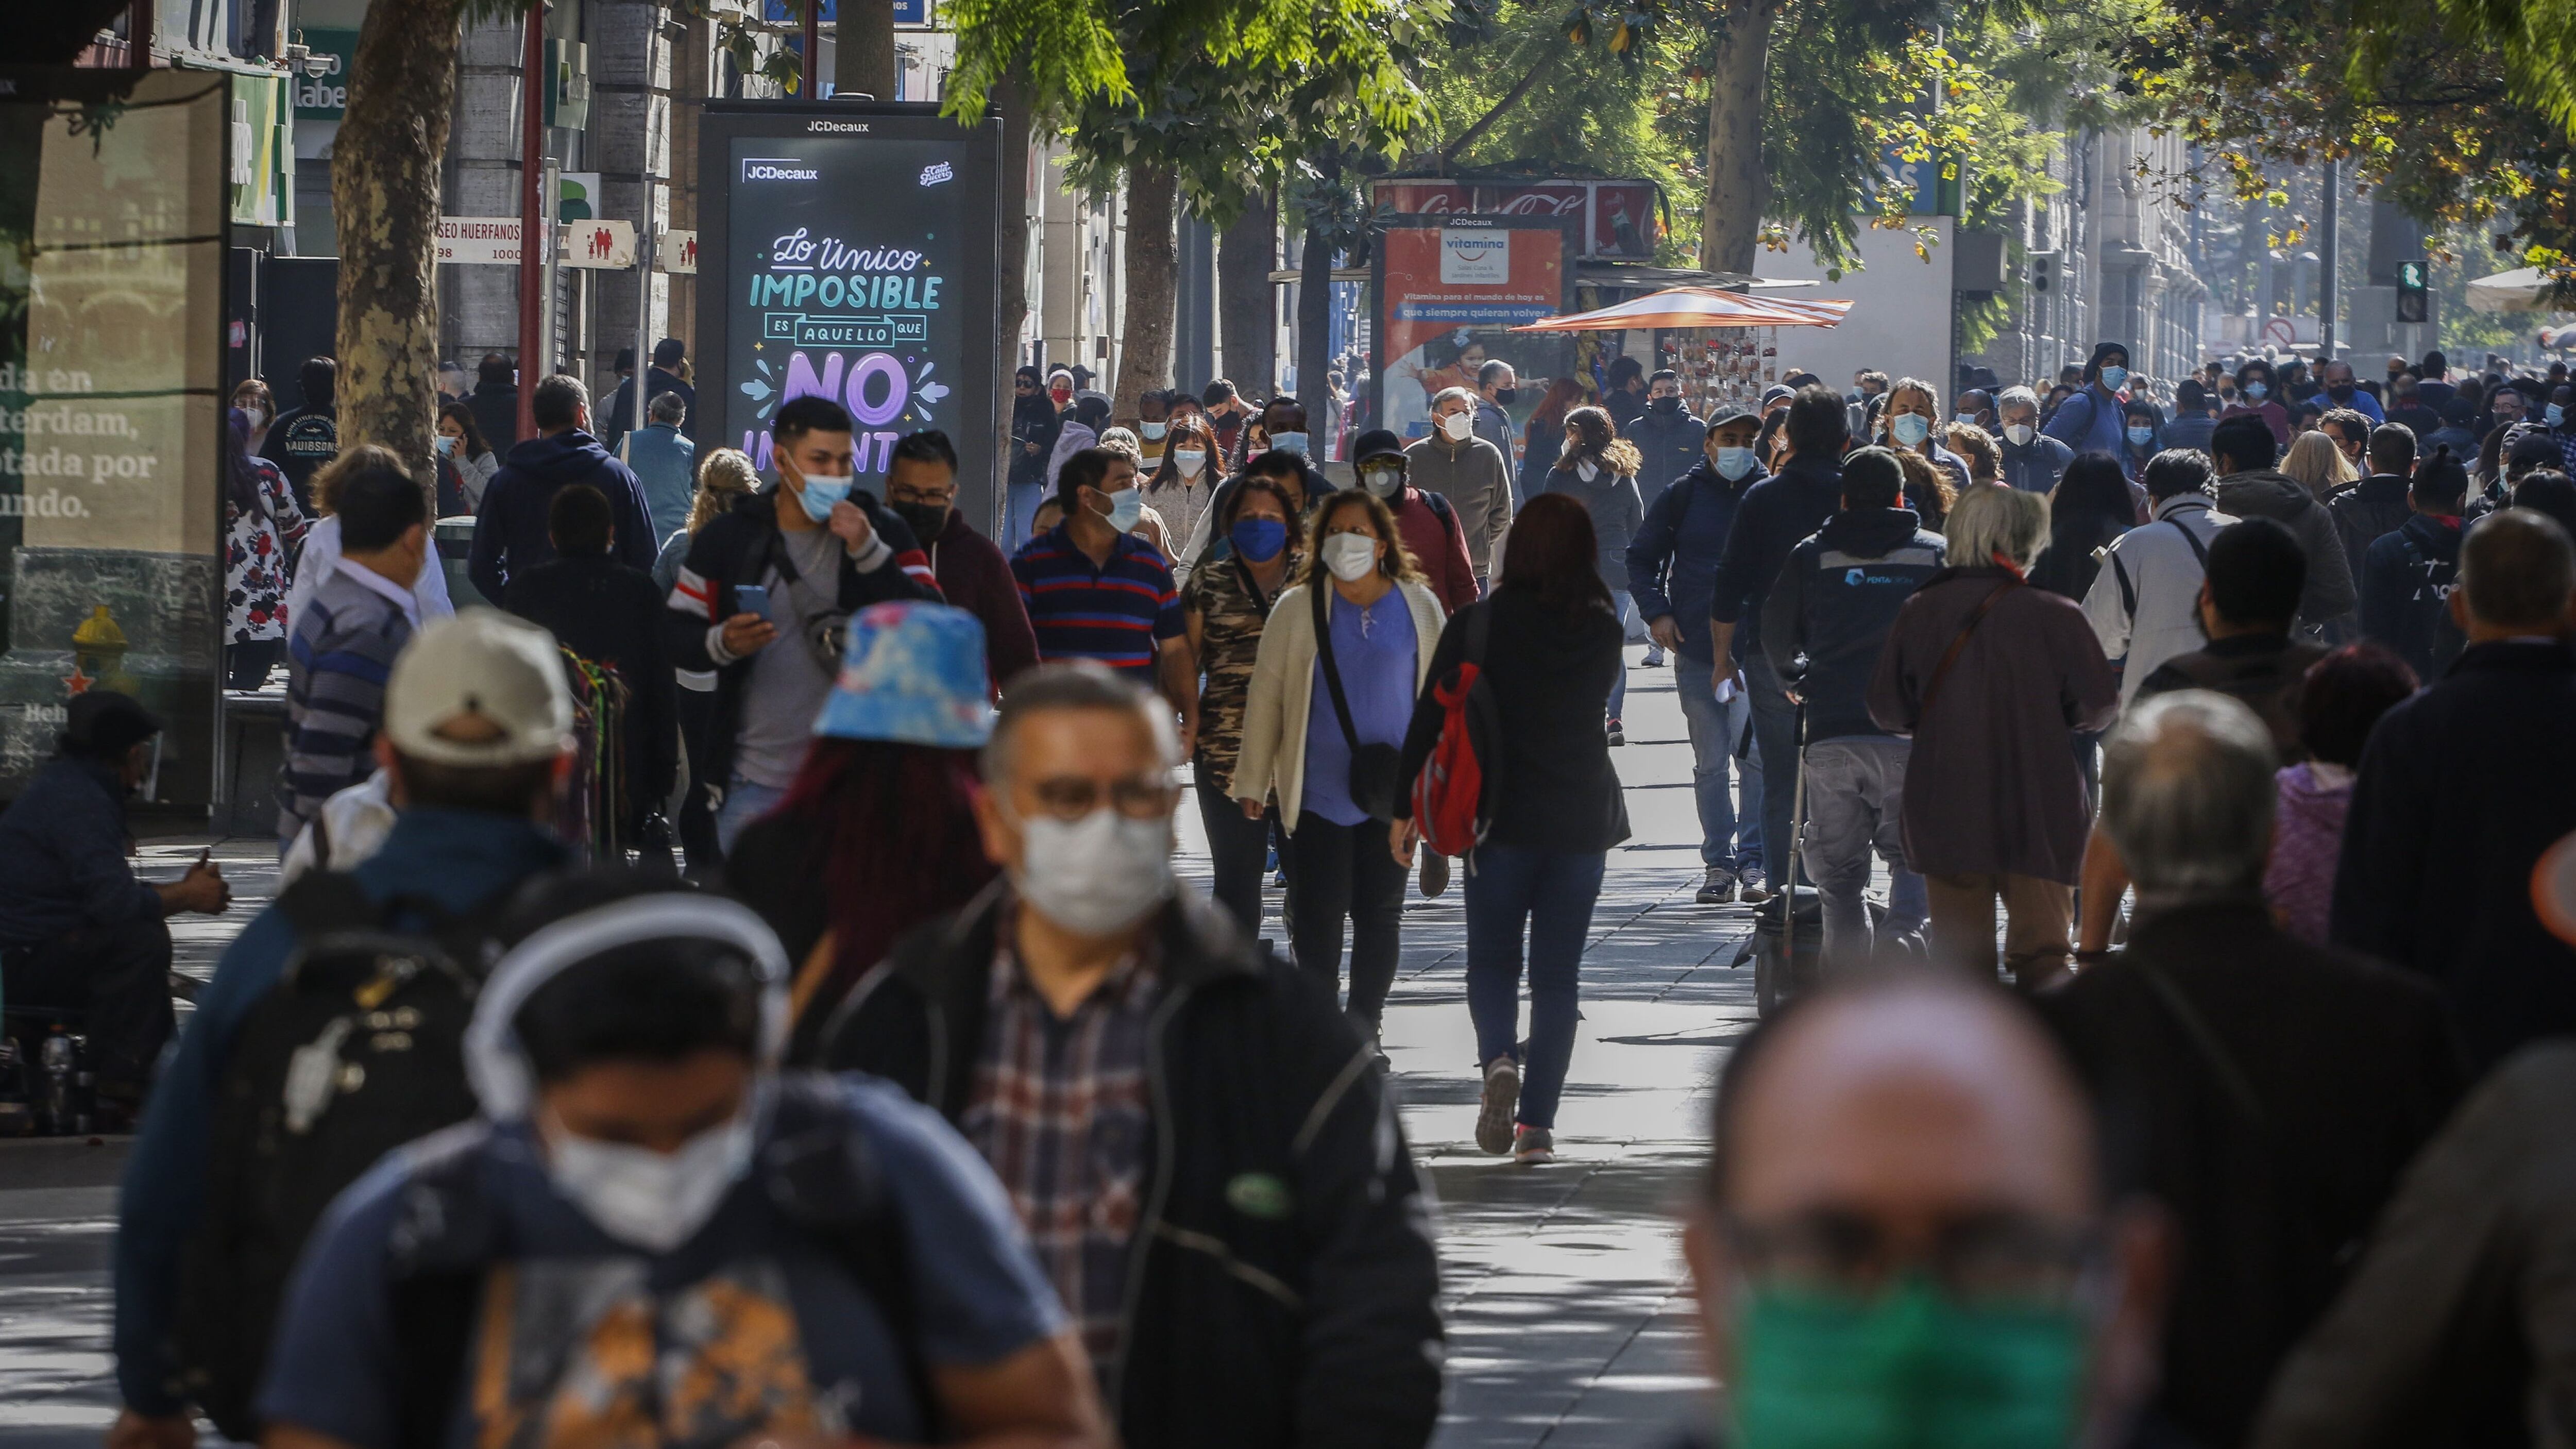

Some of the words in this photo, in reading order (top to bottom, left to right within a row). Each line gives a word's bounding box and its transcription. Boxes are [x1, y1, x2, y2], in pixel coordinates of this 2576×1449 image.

[807, 121, 869, 132] JCDecaux
[748, 165, 818, 180] JCDecaux
[1449, 218, 1493, 227] JCDecaux
[461, 223, 520, 240] HUERFANOS
[773, 227, 817, 262] Lo
[1446, 235, 1504, 249] vitamina
[749, 274, 944, 310] IMPOSIBLE
[1404, 293, 1442, 301] Vitamina
[1517, 293, 1533, 302] hoy
[1403, 309, 1423, 318] que
[1425, 309, 1468, 318] siempre
[1470, 309, 1511, 318] quieran
[1512, 309, 1546, 317] volver
[774, 321, 789, 332] ES
[804, 328, 887, 342] AQUELLO
[897, 323, 922, 334] QUE
[47, 367, 93, 392] en
[783, 350, 909, 426] NO
[0, 446, 84, 477] tada
[92, 453, 158, 485] por
